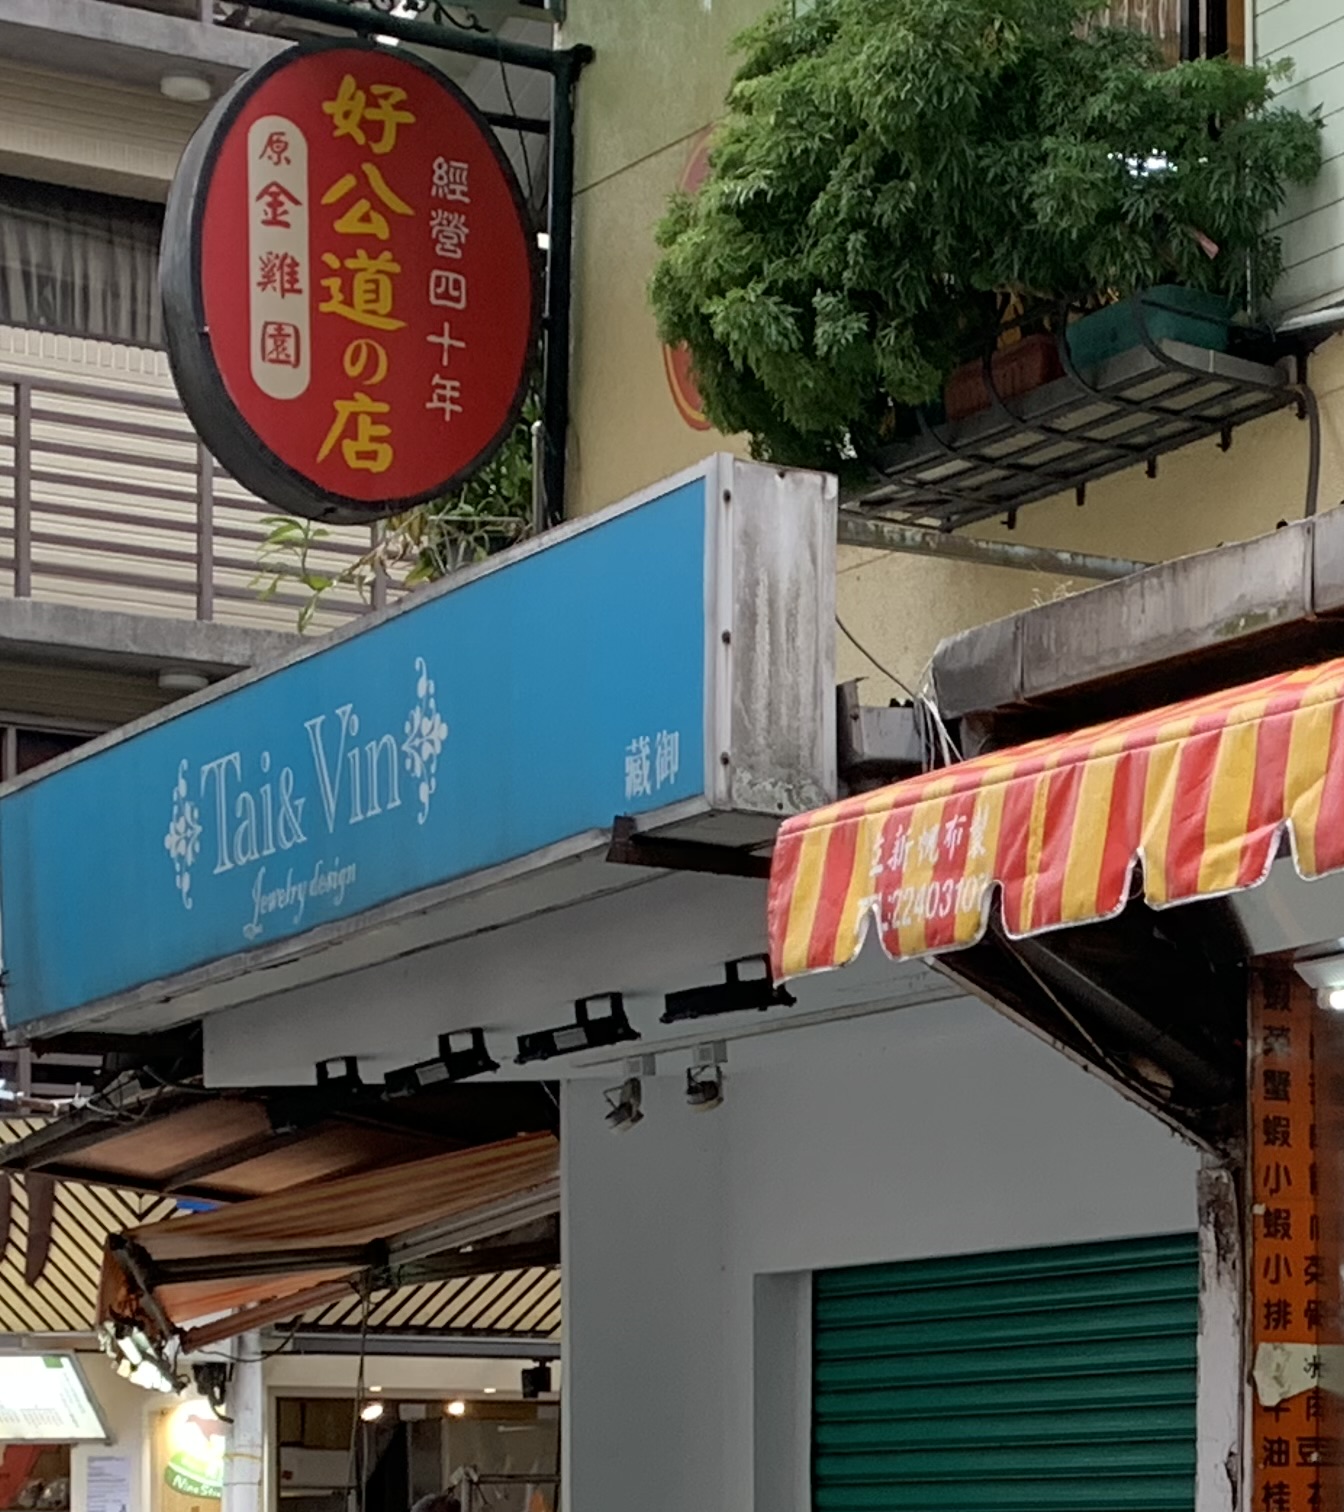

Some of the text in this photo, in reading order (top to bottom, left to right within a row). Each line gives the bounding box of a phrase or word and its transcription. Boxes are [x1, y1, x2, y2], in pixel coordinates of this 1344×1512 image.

[254, 131, 303, 370] 原金雞園
[316, 74, 416, 473] 好公道の店
[425, 156, 470, 422] 經營四十年
[303, 703, 403, 835] Vin
